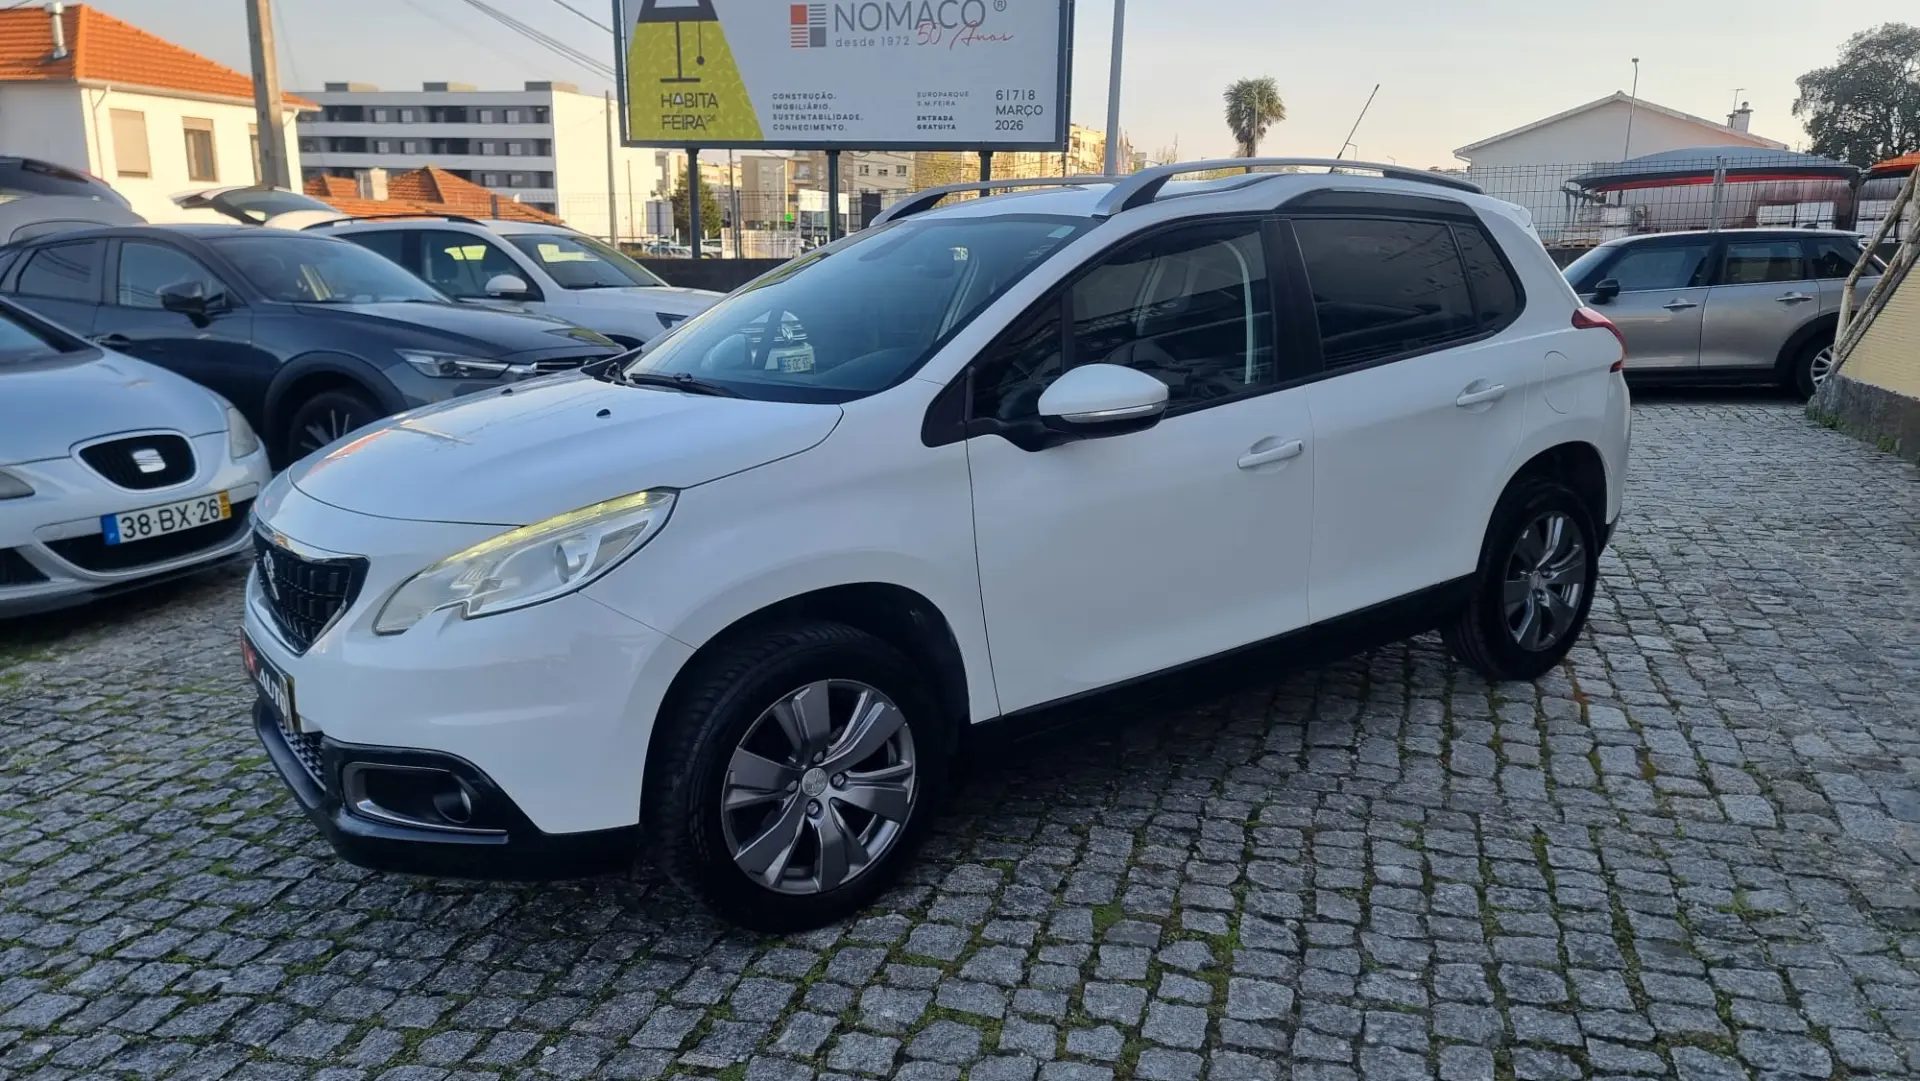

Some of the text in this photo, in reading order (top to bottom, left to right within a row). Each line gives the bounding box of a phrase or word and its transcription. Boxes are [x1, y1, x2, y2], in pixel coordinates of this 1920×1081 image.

[834, 0, 987, 32] NOMACO
[835, 36, 910, 47] desde 1972
[916, 20, 1014, 50] 50 Anos
[995, 104, 1044, 118] MARÇO
[995, 120, 1024, 131] 2026
